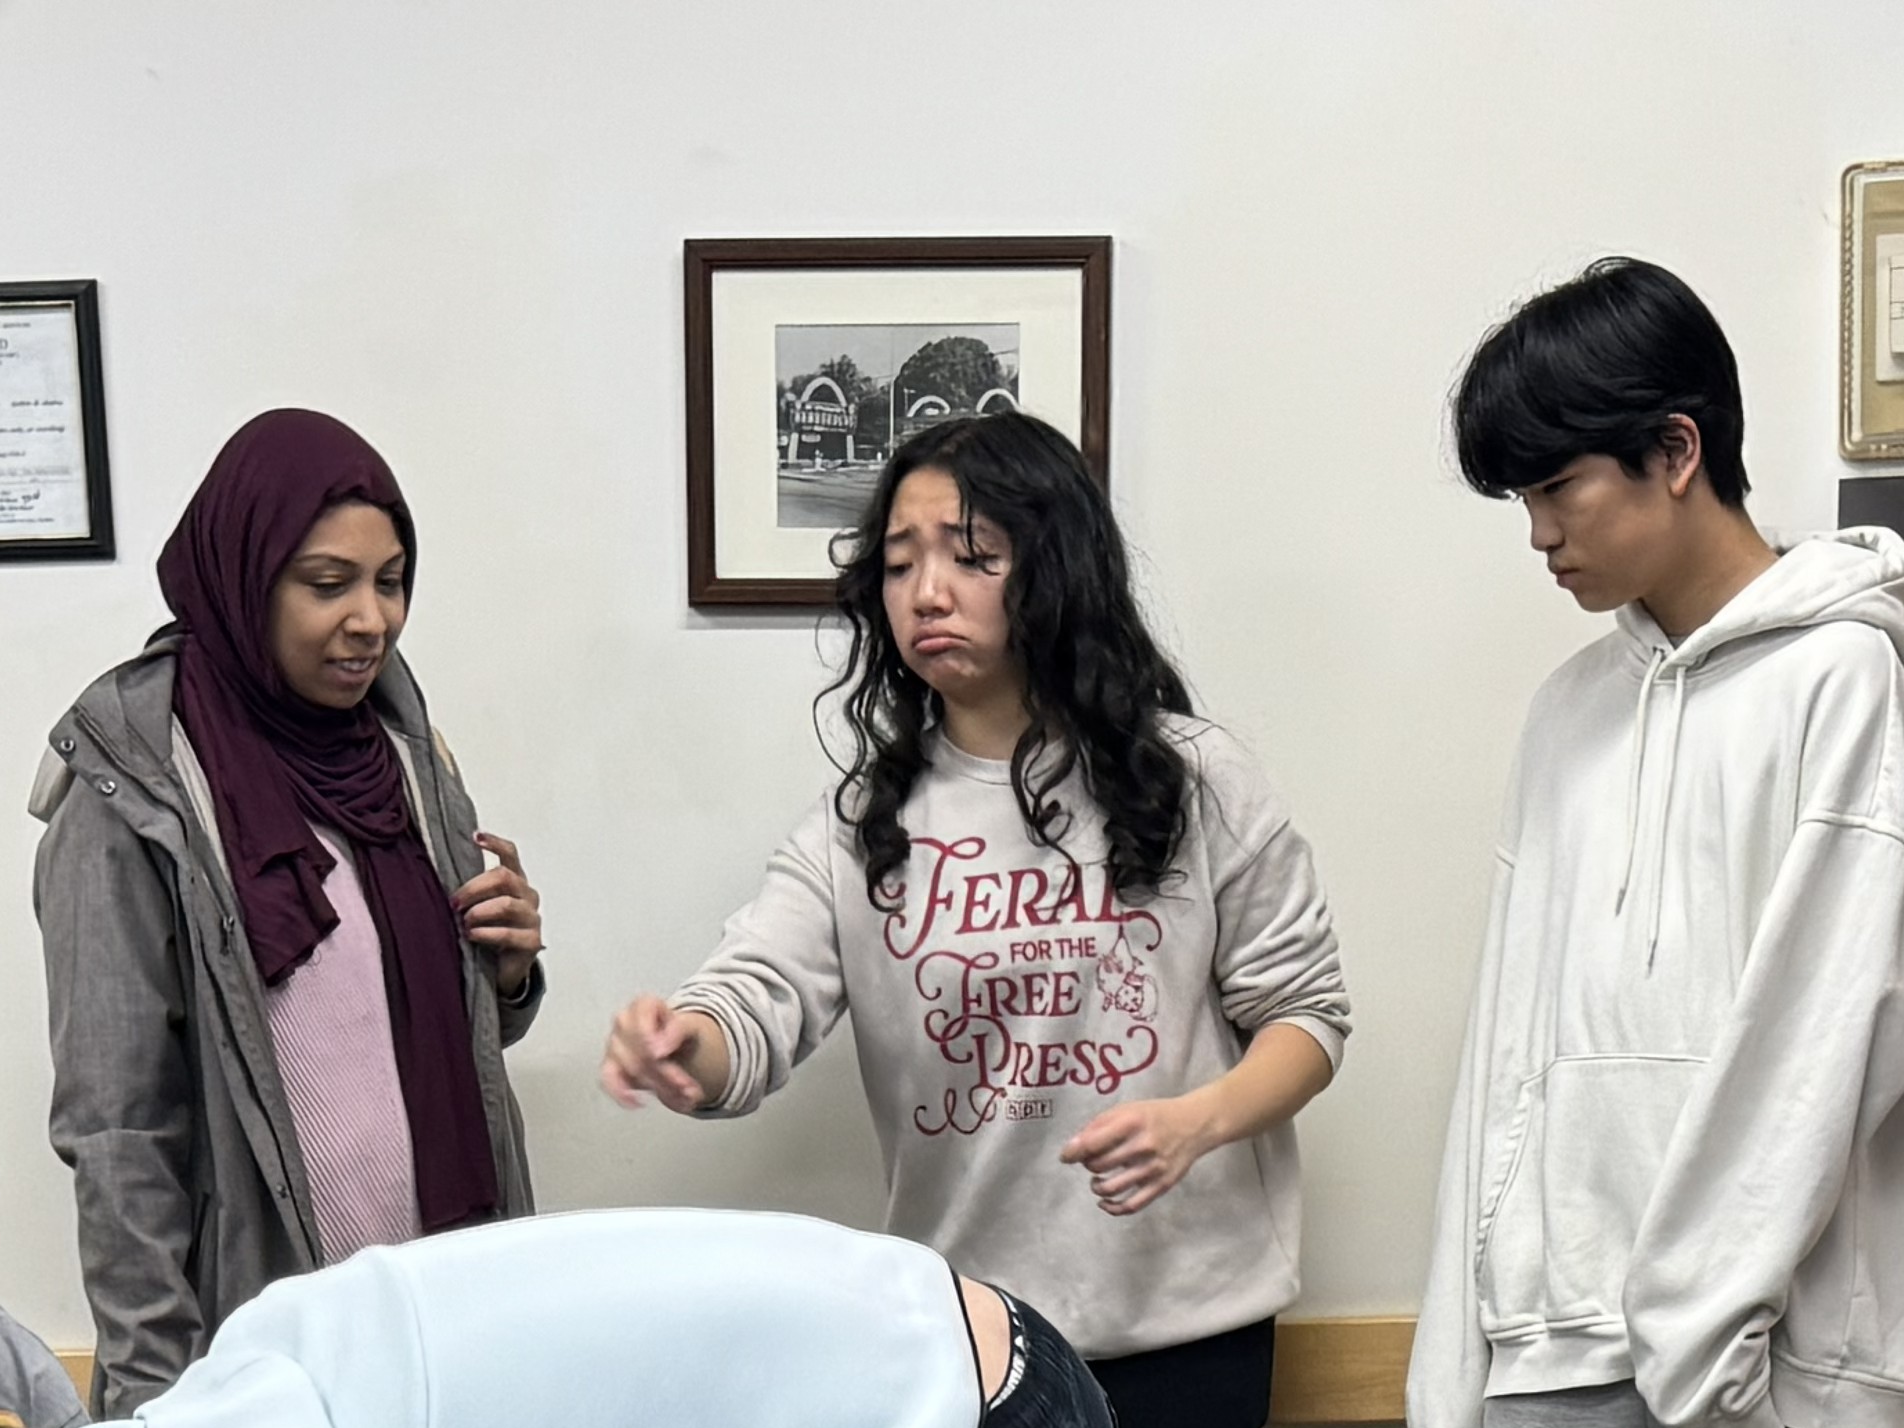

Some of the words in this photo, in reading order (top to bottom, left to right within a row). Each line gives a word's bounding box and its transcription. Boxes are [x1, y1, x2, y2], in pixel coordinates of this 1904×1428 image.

[884, 837, 1162, 960] FERAL
[915, 951, 1081, 1024] FREE
[1010, 941, 1053, 963] FOR
[1056, 936, 1098, 959] THE
[937, 1014, 1159, 1095] PRESS
